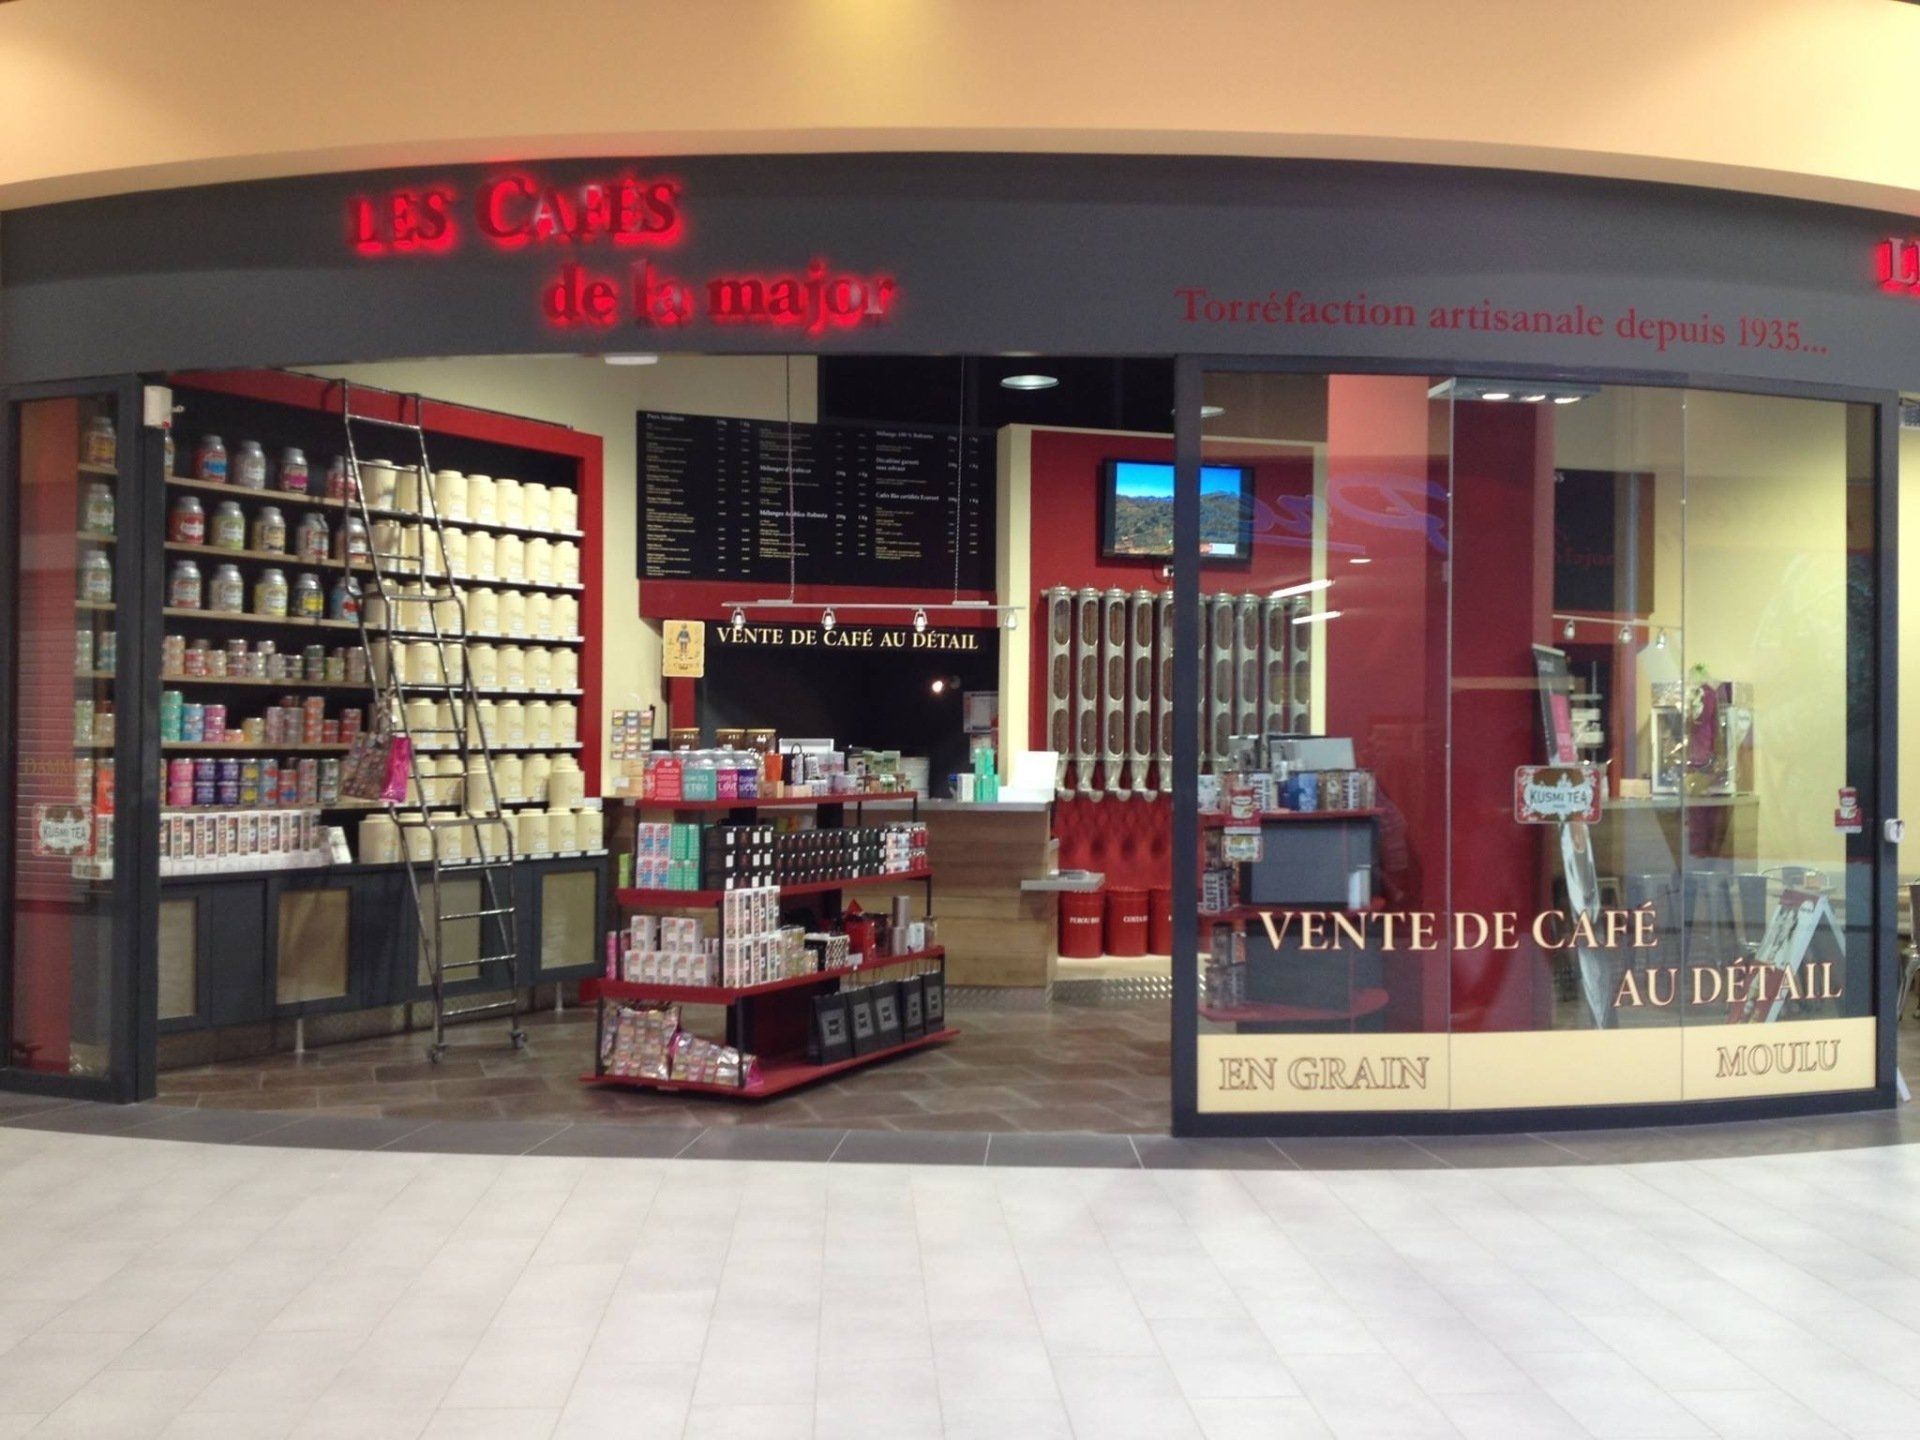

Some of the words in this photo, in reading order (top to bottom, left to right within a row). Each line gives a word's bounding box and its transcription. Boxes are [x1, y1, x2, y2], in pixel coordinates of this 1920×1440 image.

[352, 190, 454, 249] LES
[543, 262, 618, 324] de
[633, 258, 694, 326] la
[706, 259, 895, 335] major
[1174, 288, 1416, 326] Torréfaction
[1428, 300, 1604, 338] artisanale
[1615, 308, 1726, 353] depuis
[716, 627, 784, 645] VENTE
[791, 630, 817, 645] DE
[823, 628, 874, 647] CAFÉ
[880, 631, 906, 647] AU
[912, 630, 979, 650] DÉTAIL
[1529, 789, 1565, 804] KUSMI
[1567, 791, 1588, 805] TEA
[1258, 910, 1439, 951] VENTE
[1452, 911, 1520, 951] DE
[1531, 900, 1659, 950] CAFÉ
[1612, 968, 1679, 1008] AU
[1691, 956, 1847, 1006] DÉTAIL
[1218, 1056, 1279, 1091] EN
[1286, 1056, 1431, 1091] GRAIN
[1714, 1038, 1842, 1079] MOULU
